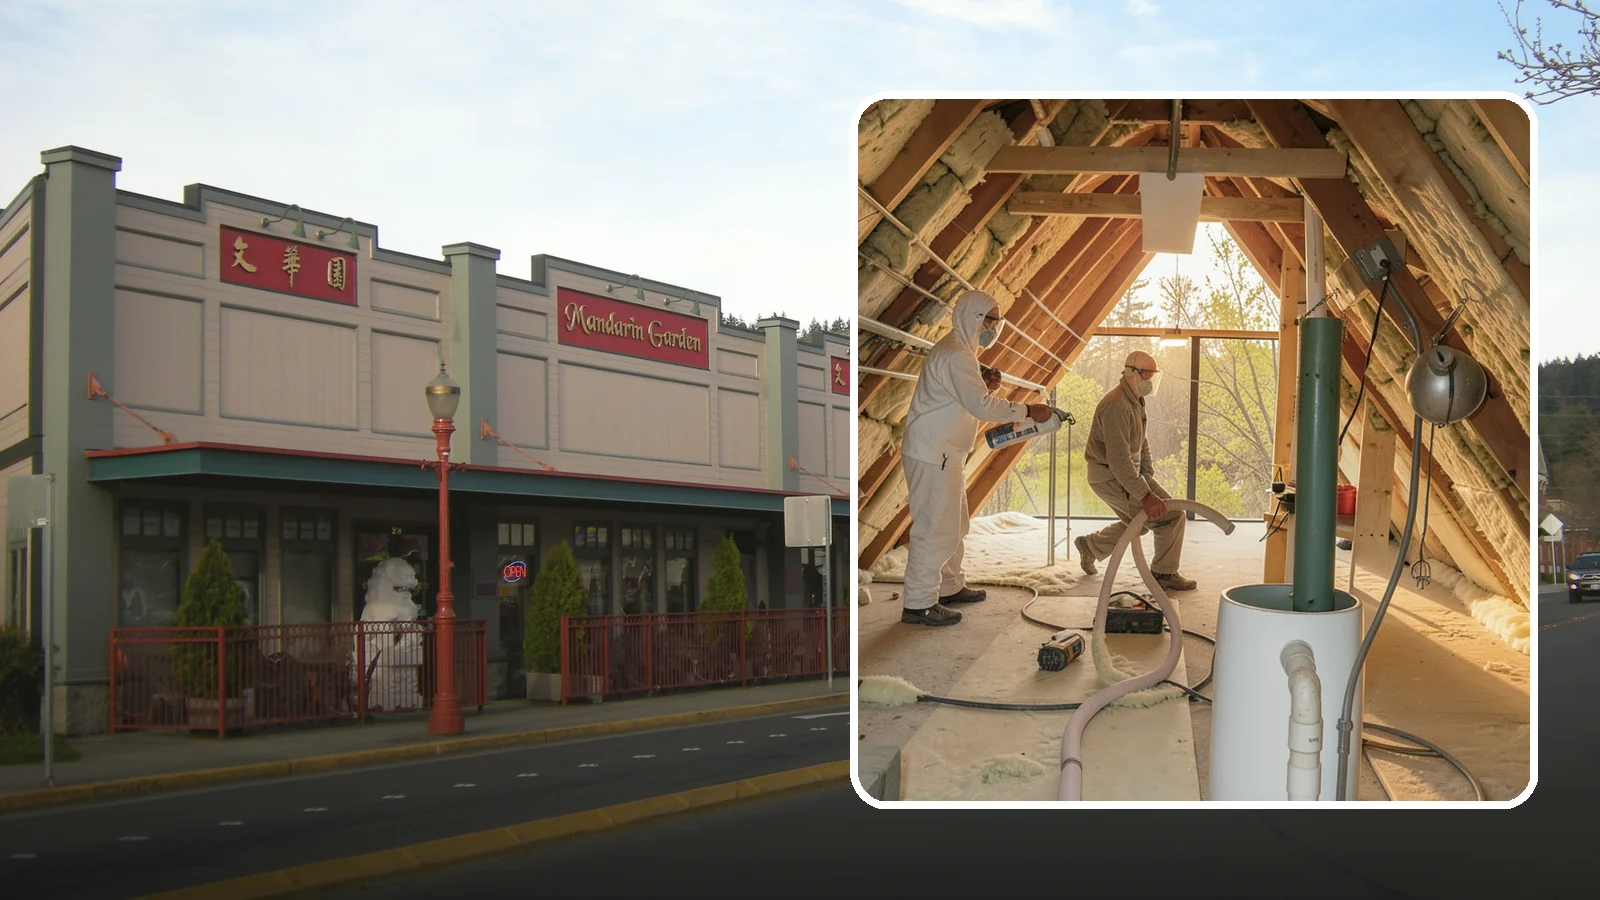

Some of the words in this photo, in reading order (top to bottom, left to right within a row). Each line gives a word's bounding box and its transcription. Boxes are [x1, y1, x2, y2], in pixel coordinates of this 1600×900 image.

[564, 302, 644, 341] Mandarin
[648, 320, 701, 352] Garden
[503, 565, 527, 578] OPEN
